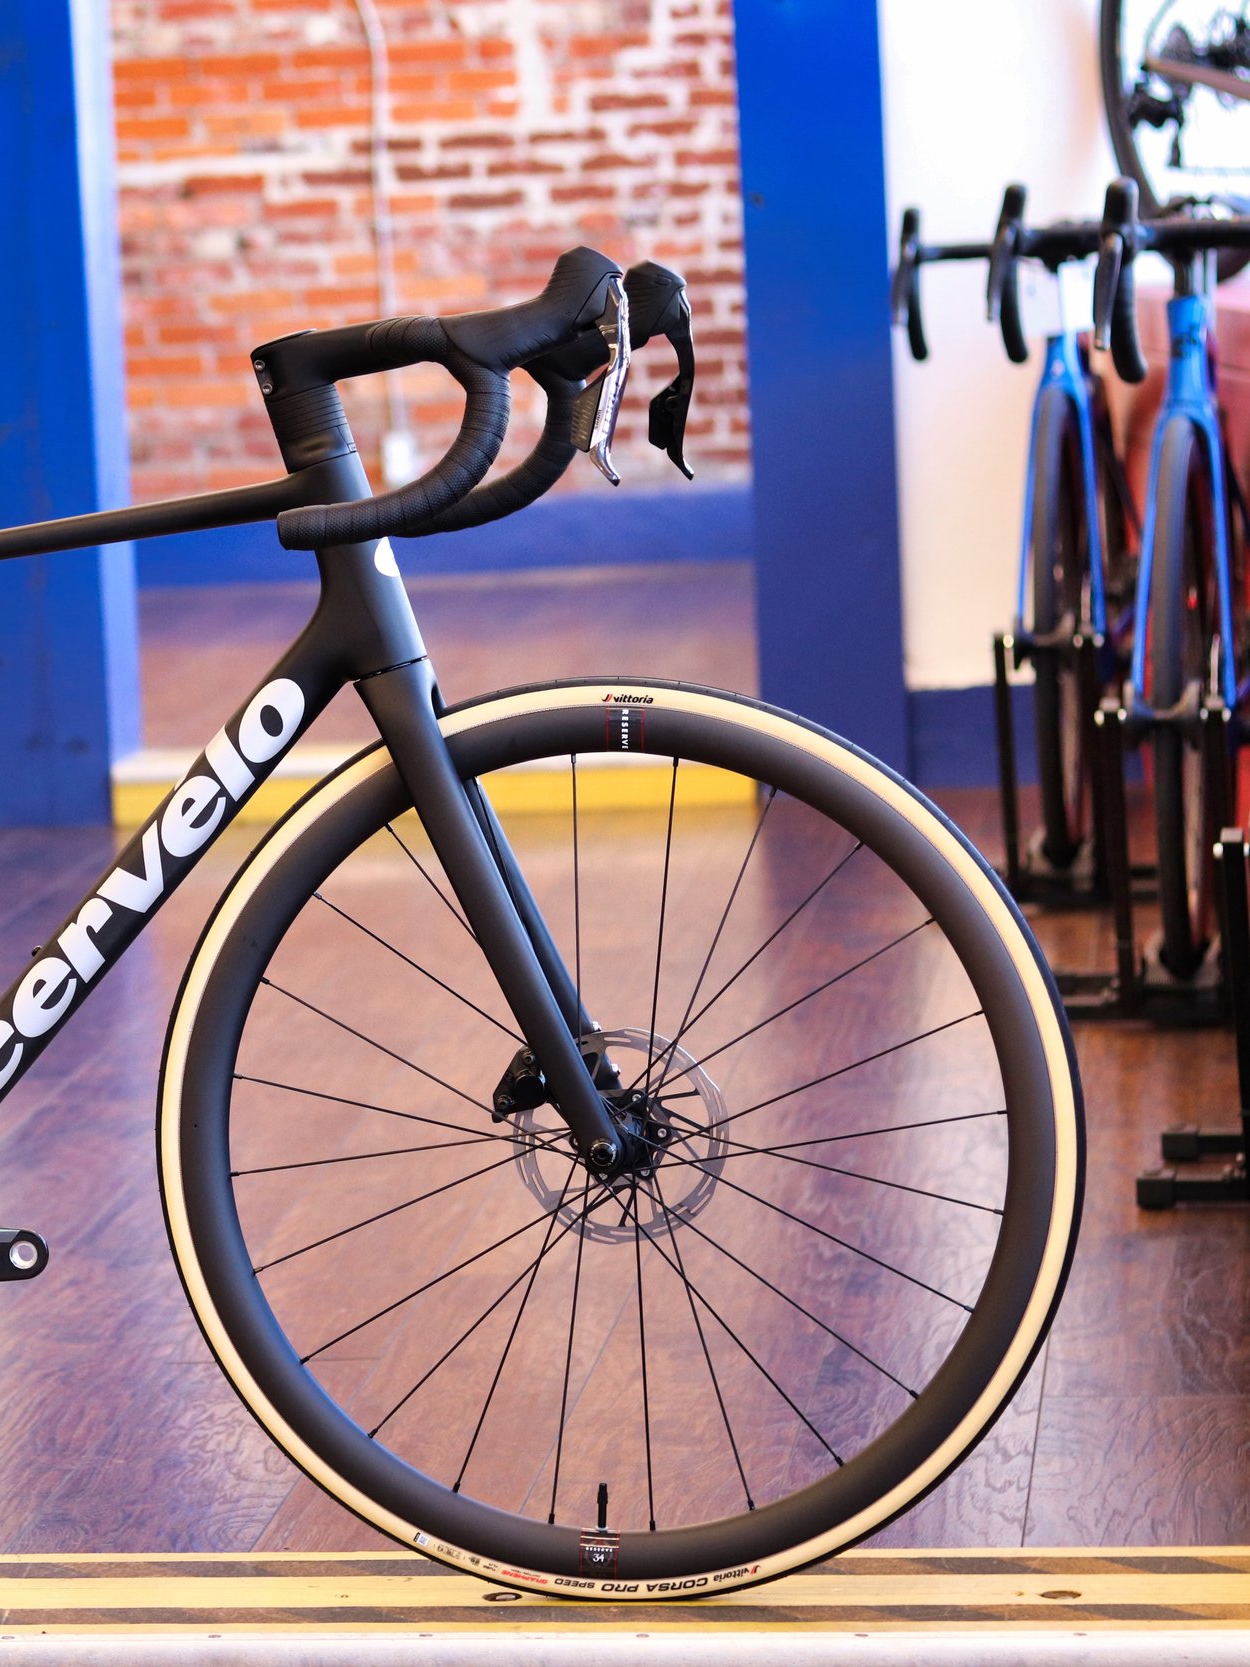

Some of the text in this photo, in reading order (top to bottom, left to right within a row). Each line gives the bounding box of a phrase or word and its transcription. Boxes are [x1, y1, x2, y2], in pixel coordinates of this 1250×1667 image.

[613, 693, 654, 704] vittoria
[621, 709, 629, 749] RESERVE
[592, 1553, 605, 1562] 34
[554, 1578, 595, 1589] SPEED
[601, 1583, 639, 1593] PRO
[646, 1577, 708, 1592] CORSA
